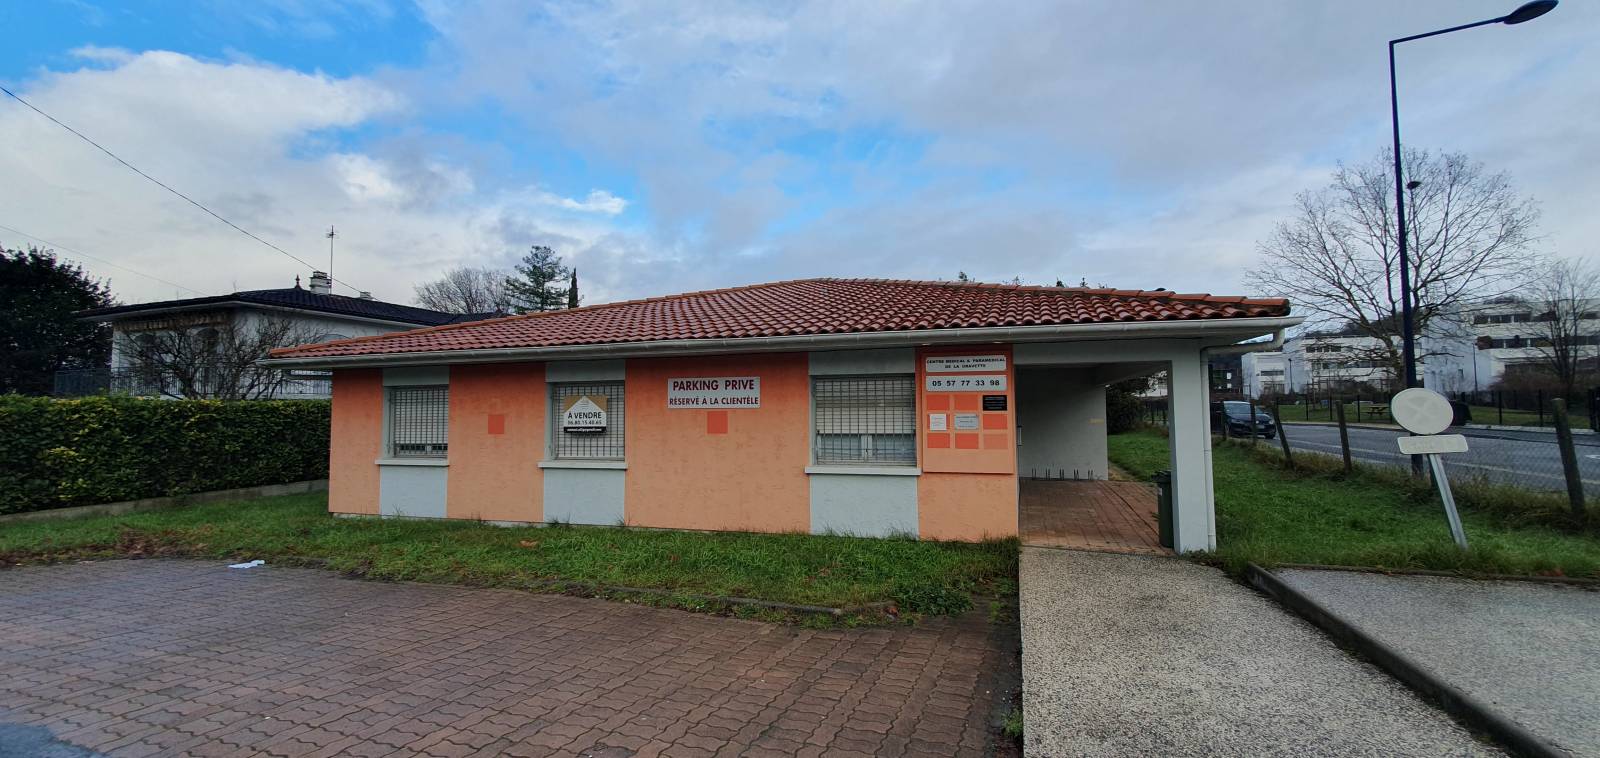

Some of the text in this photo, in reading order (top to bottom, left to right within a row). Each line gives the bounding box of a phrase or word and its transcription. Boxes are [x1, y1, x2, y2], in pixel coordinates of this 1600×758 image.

[672, 379, 755, 391] PARKING PRIVE
[669, 395, 759, 405] RÉSERVÉ À LA CLIENTÈLE
[574, 411, 602, 419] VENDRE
